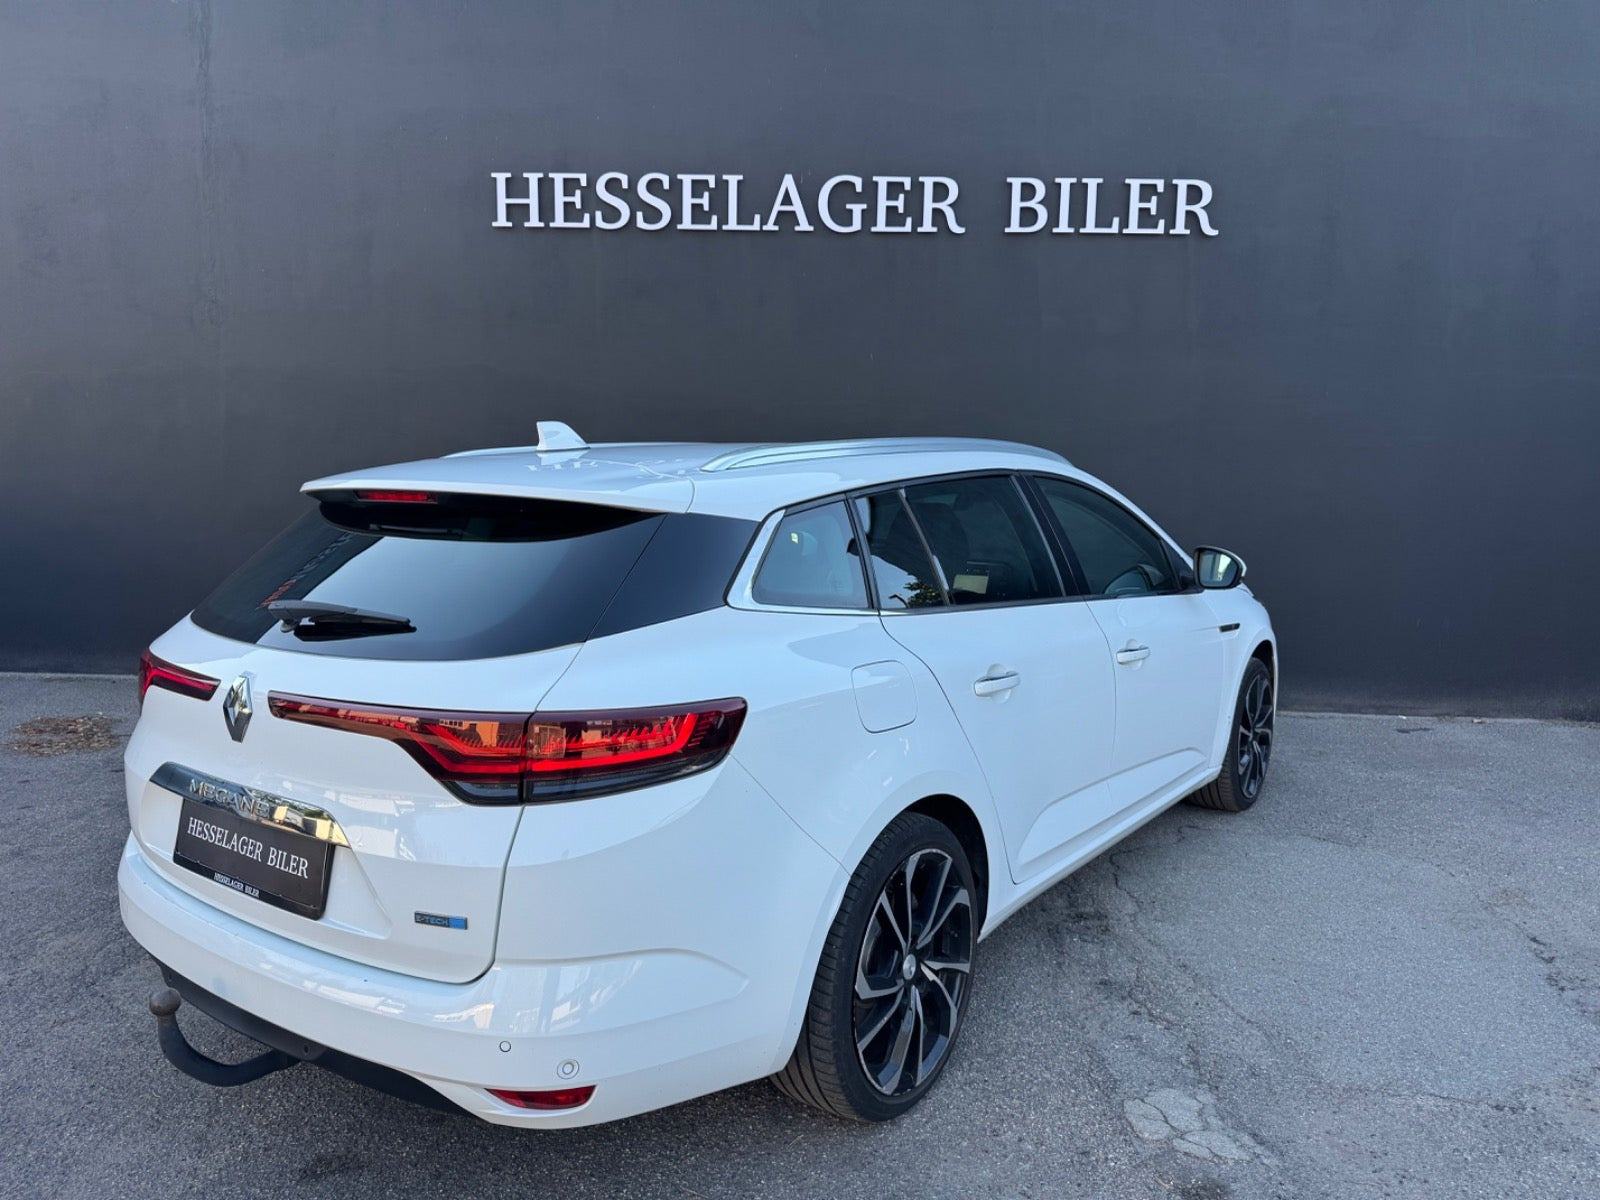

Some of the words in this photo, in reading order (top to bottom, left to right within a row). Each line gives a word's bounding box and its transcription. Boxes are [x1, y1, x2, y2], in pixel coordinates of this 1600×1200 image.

[490, 171, 966, 234] HESSELAGER
[1004, 176, 1220, 237] BILER
[189, 778, 270, 819] MEGANE
[187, 816, 262, 863] HESSELAGER
[267, 846, 309, 880] BILER
